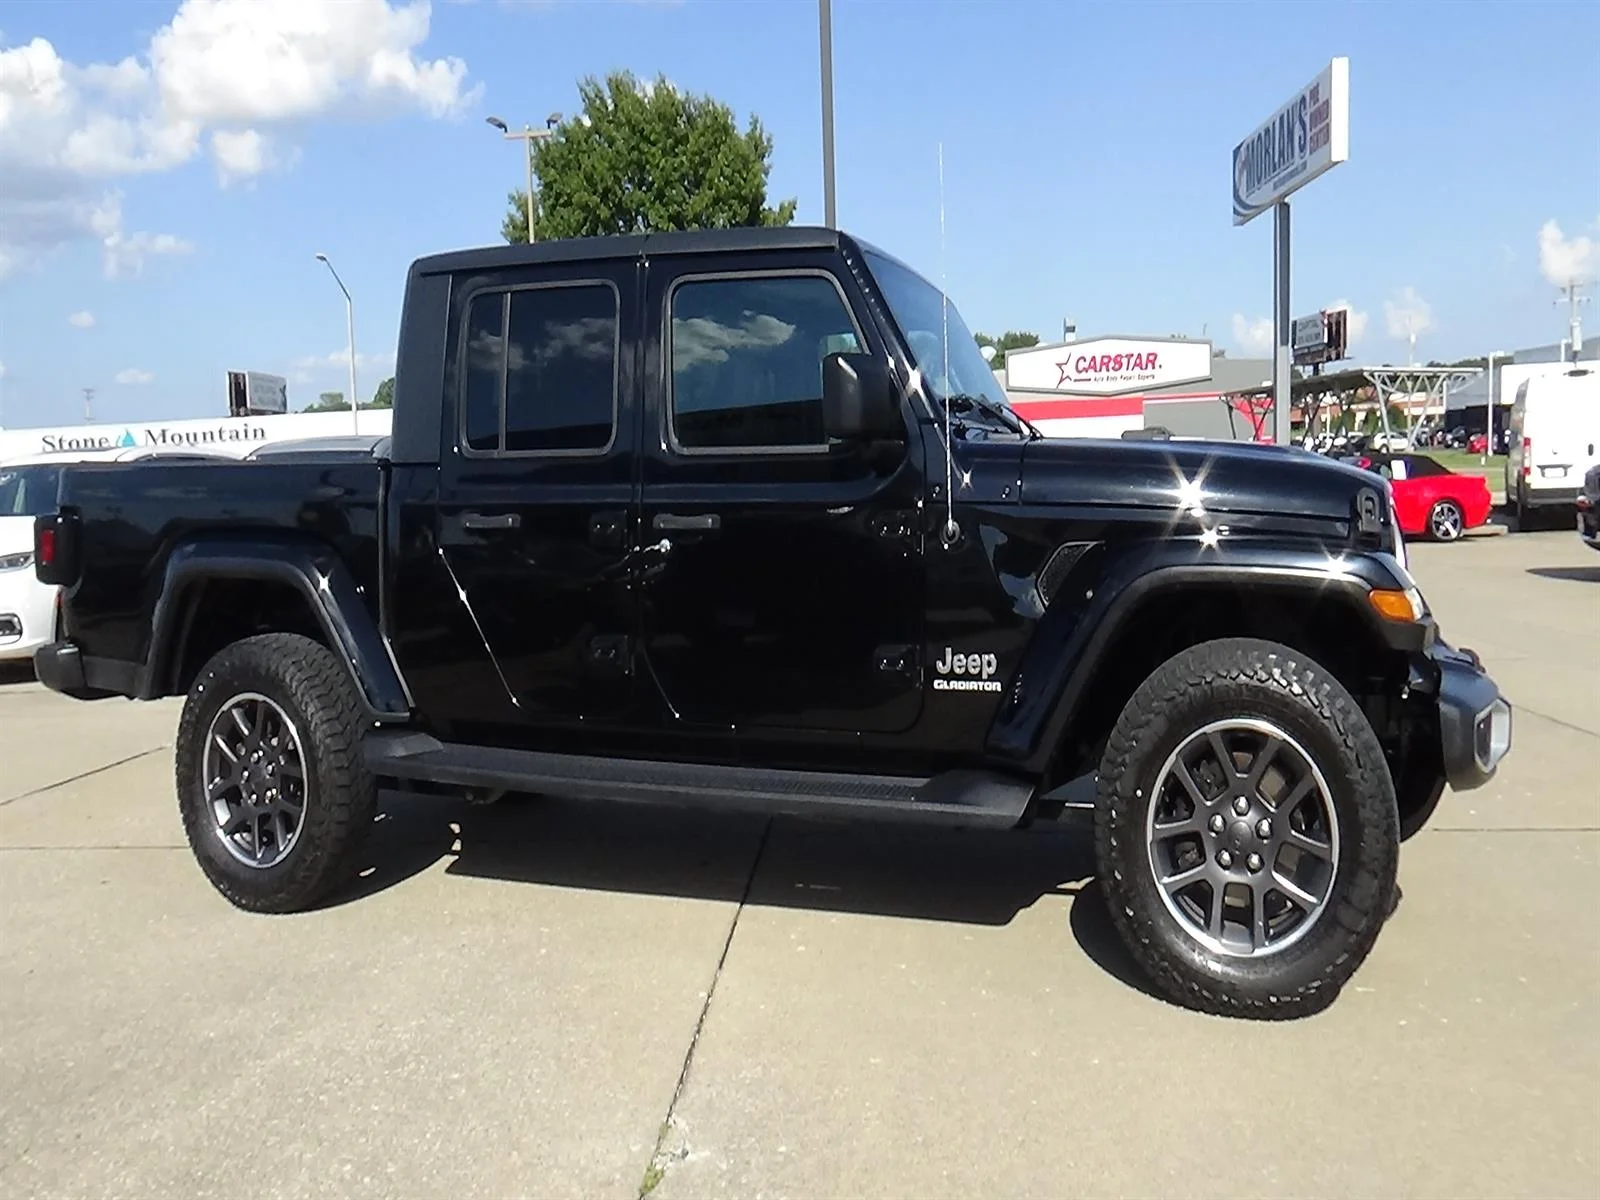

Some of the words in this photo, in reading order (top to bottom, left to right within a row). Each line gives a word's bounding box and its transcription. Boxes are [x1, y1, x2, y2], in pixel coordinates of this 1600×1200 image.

[42, 435, 110, 452] Stone
[144, 422, 267, 446] Mountain
[936, 647, 997, 679] Jeep
[933, 679, 1002, 692] GLADIATOR
